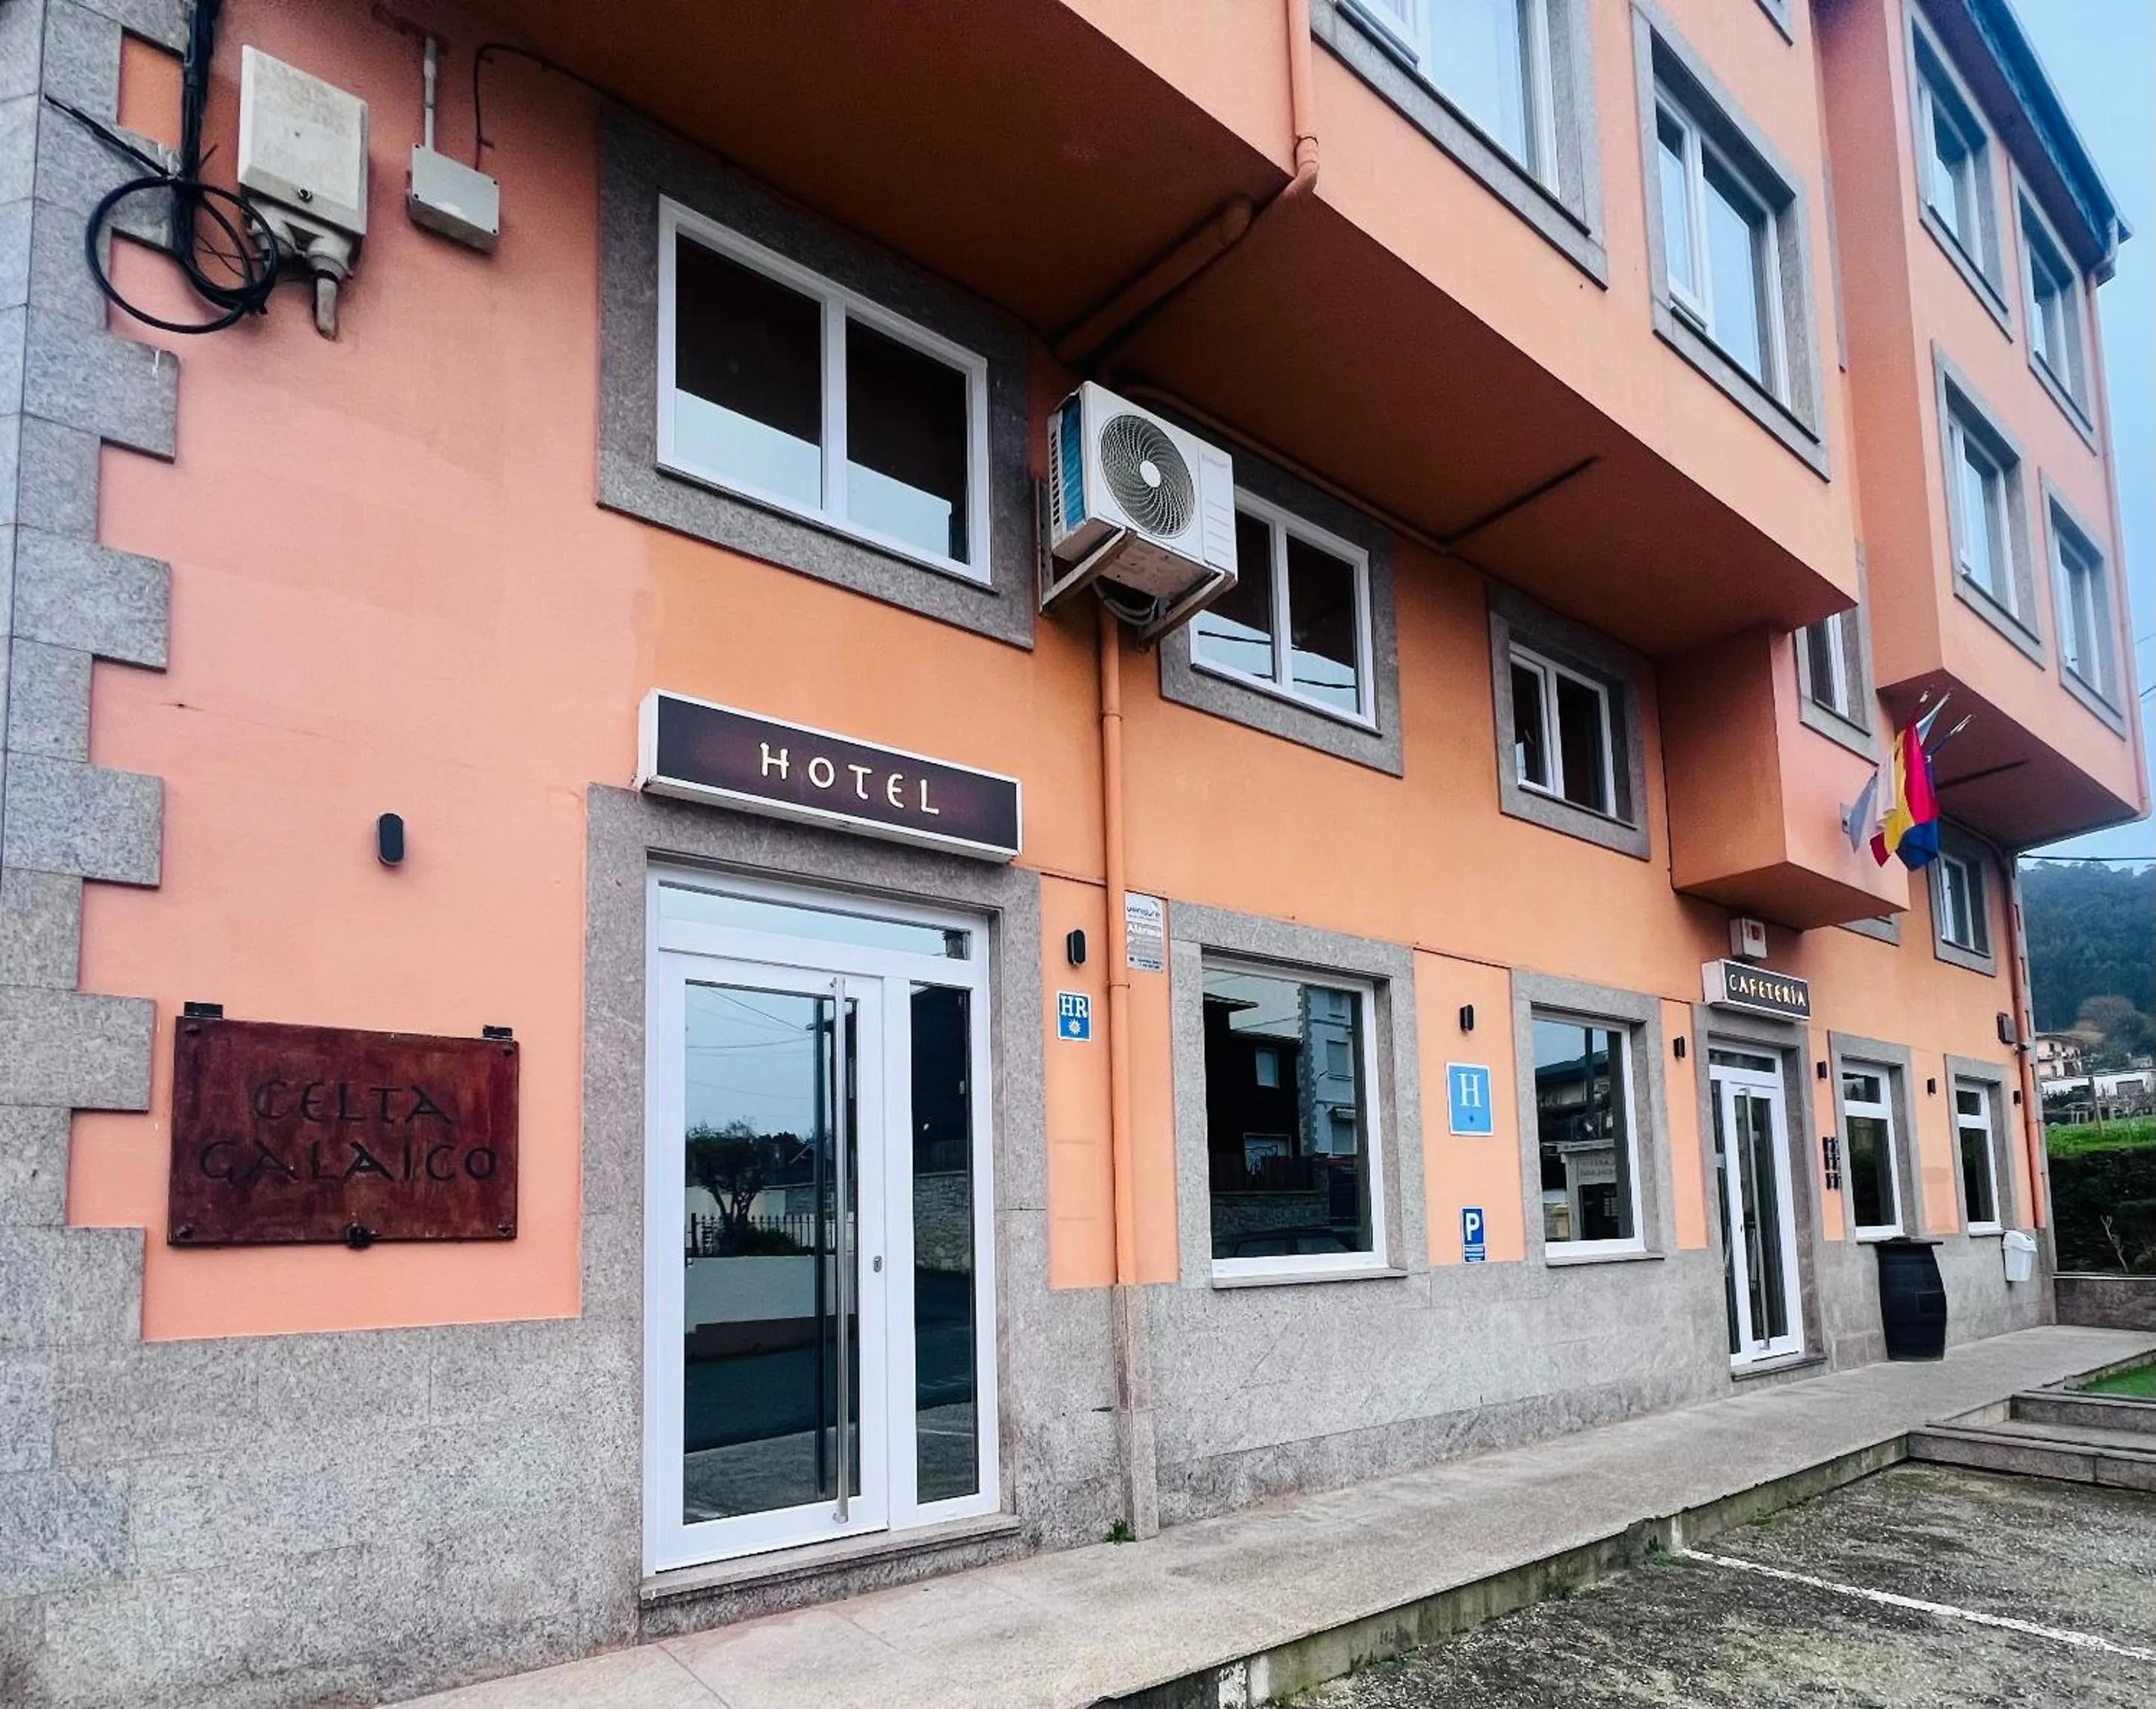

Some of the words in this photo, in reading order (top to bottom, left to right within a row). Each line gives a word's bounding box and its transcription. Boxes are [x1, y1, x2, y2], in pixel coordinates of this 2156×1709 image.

[759, 742, 940, 815] HOTEL
[1060, 995, 1088, 1018] HR
[1728, 974, 1807, 1007] CAFETERÍA
[252, 1079, 452, 1124] CELTA
[1457, 1073, 1483, 1108] H
[198, 1138, 497, 1182] GALAICO
[1465, 1212, 1481, 1242] P
